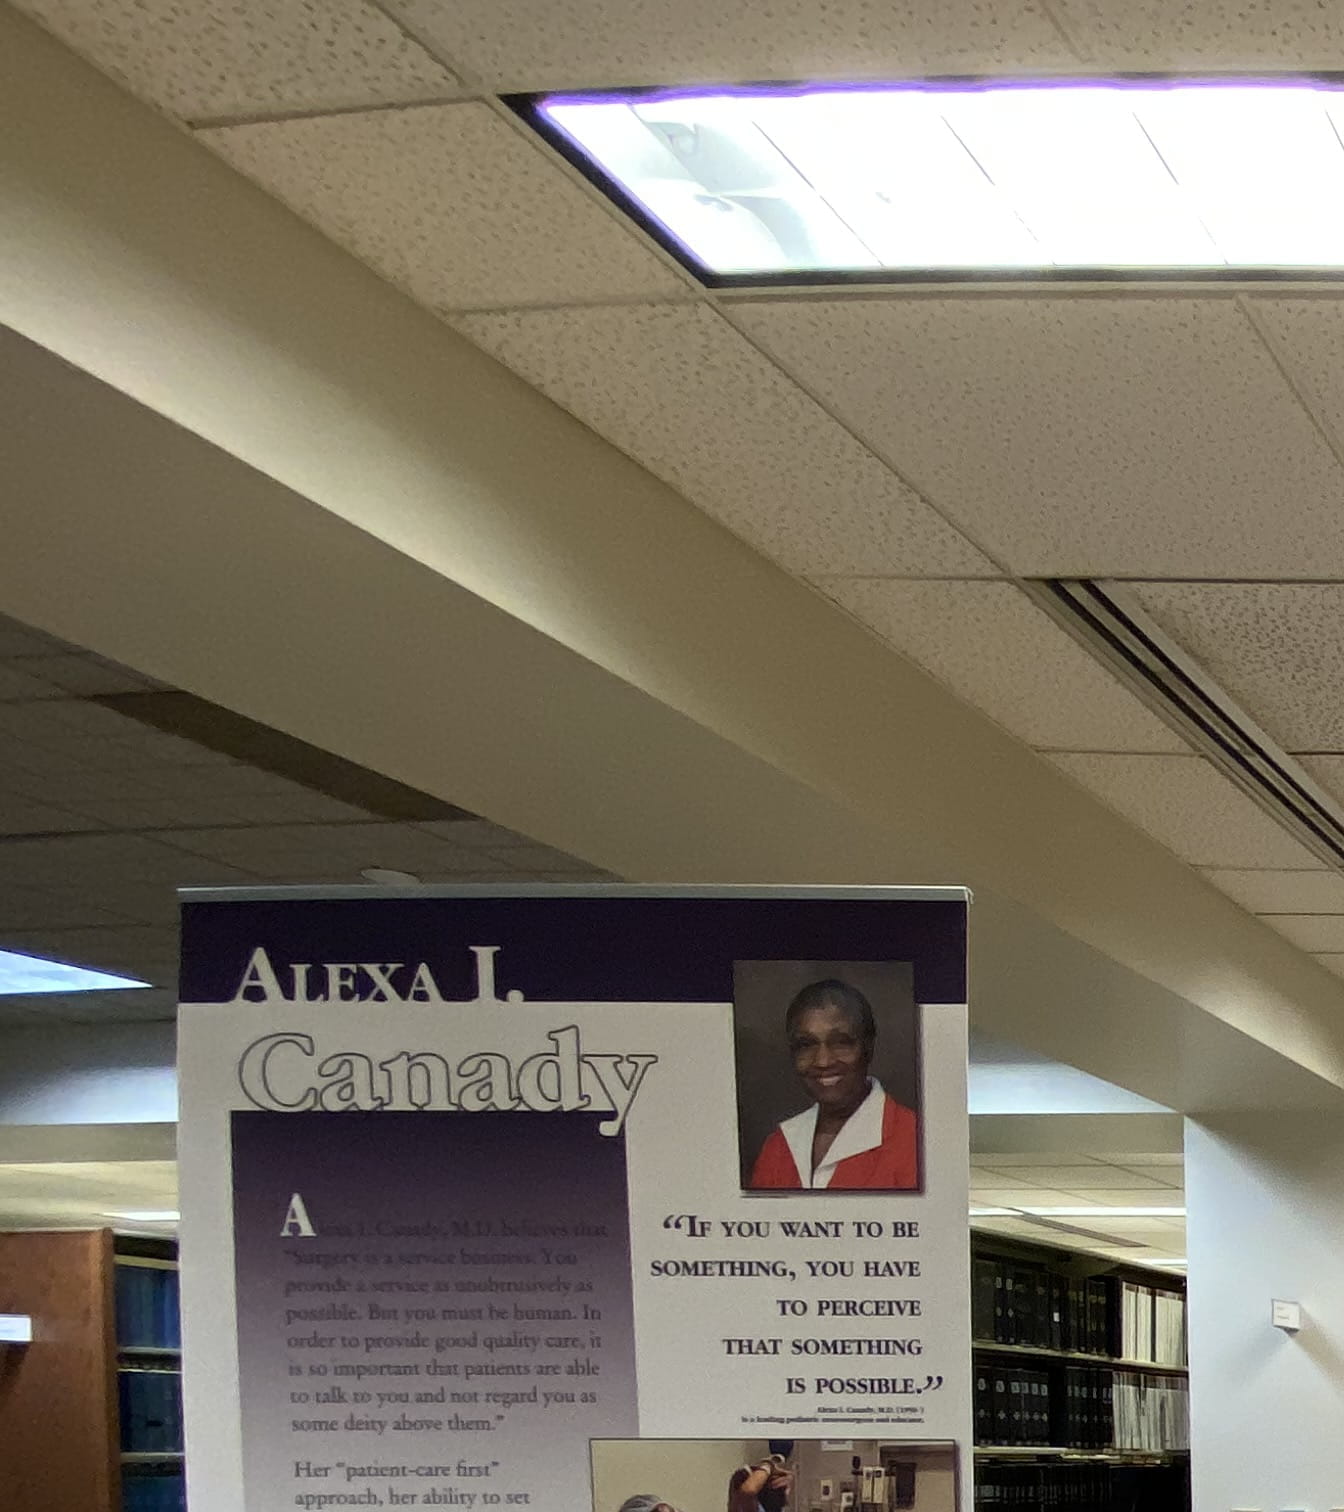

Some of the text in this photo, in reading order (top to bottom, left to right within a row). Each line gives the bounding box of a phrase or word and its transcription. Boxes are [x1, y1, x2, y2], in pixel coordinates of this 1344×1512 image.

[233, 945, 525, 1002] ALEXA I.
[238, 1025, 659, 1137] Canady
[663, 1214, 919, 1238] "IF YOU WANT TO BE
[650, 1260, 921, 1281] SOMETHING, YOU HAVE
[776, 1299, 922, 1316] TO PERCEIVE
[721, 1338, 923, 1355] THAT SOMETHING
[786, 1375, 943, 1394] IS POSSIBLE."
[294, 1459, 500, 1481] Her "patient-care first"
